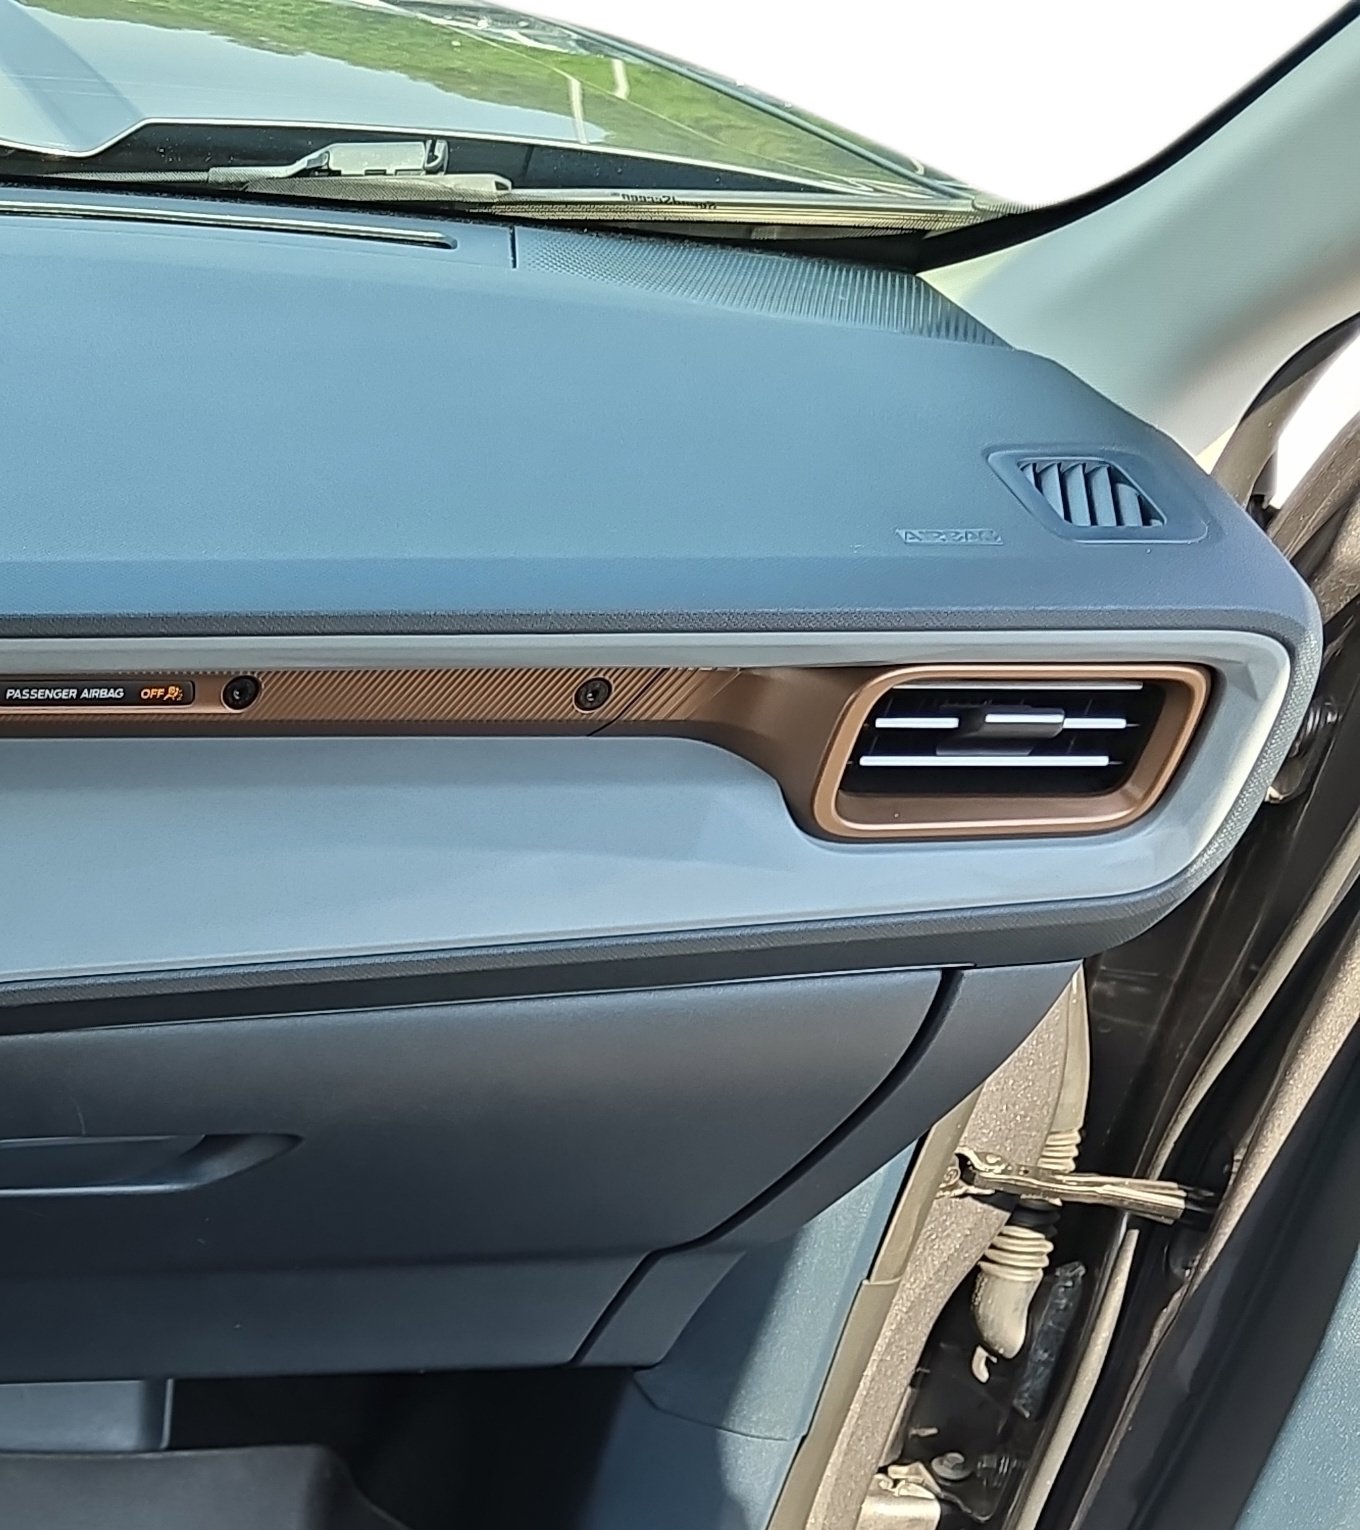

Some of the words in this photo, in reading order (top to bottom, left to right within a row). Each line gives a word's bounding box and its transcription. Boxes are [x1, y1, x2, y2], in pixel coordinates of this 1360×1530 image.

[5, 687, 78, 701] PASSENGER
[79, 687, 125, 700] AIRBAG
[139, 687, 165, 701] OFF
